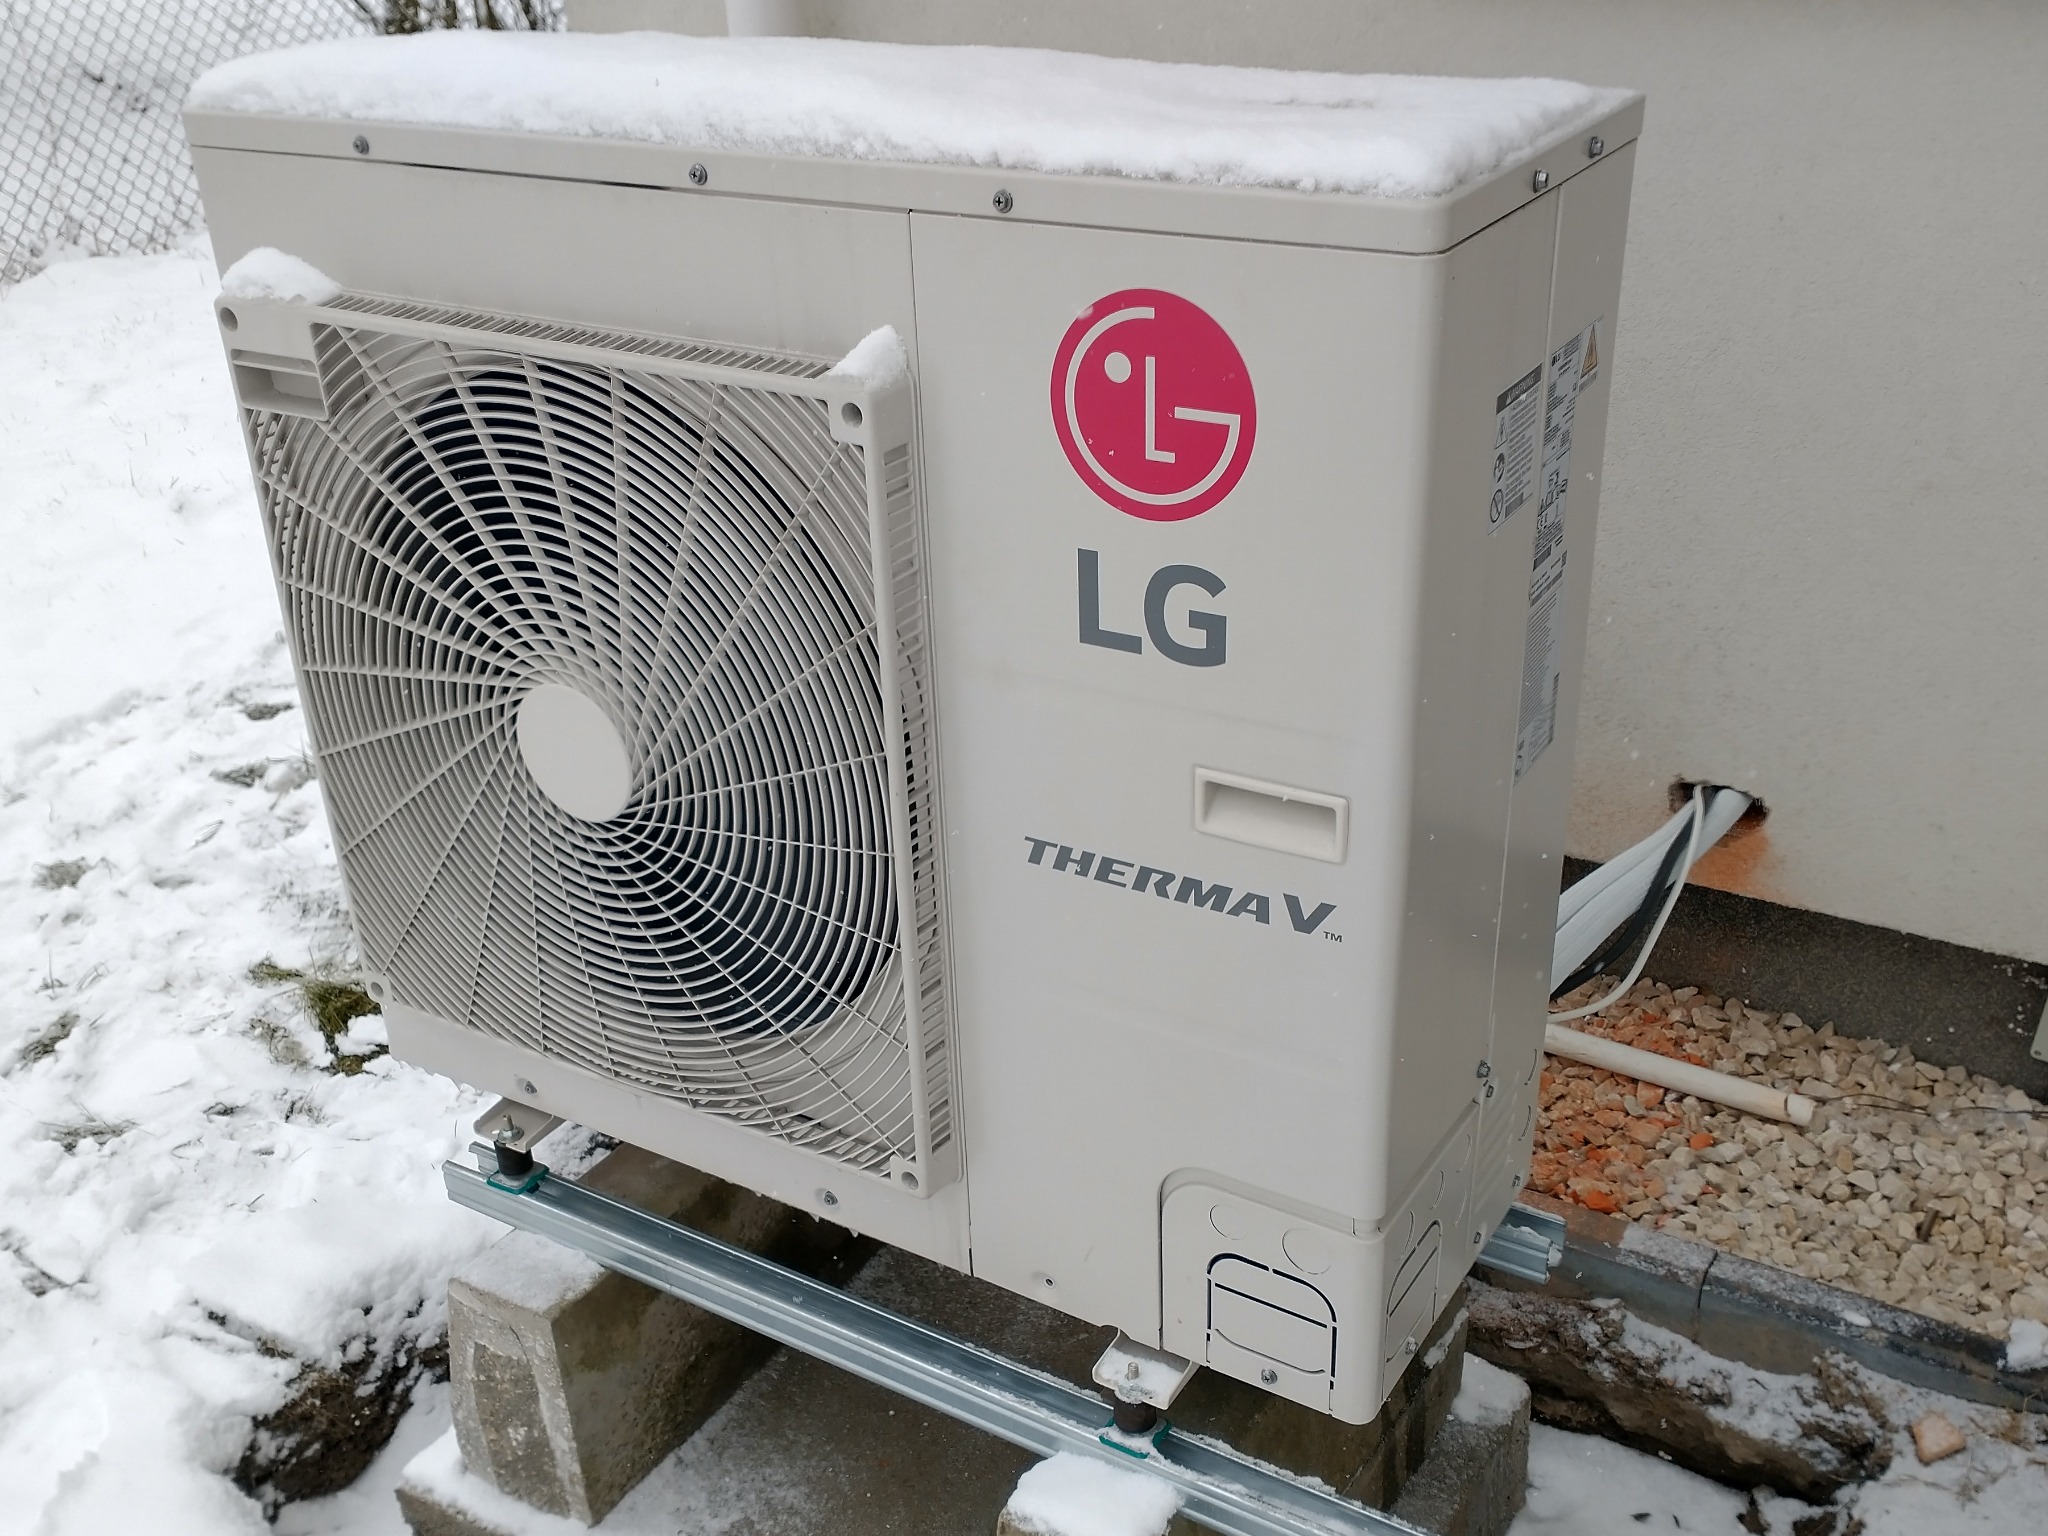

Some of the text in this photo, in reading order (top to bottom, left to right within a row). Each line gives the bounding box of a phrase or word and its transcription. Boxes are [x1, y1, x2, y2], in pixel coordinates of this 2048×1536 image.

[1077, 547, 1227, 668] LG
[1024, 836, 1270, 925] THERMA
[1282, 893, 1337, 935] V
